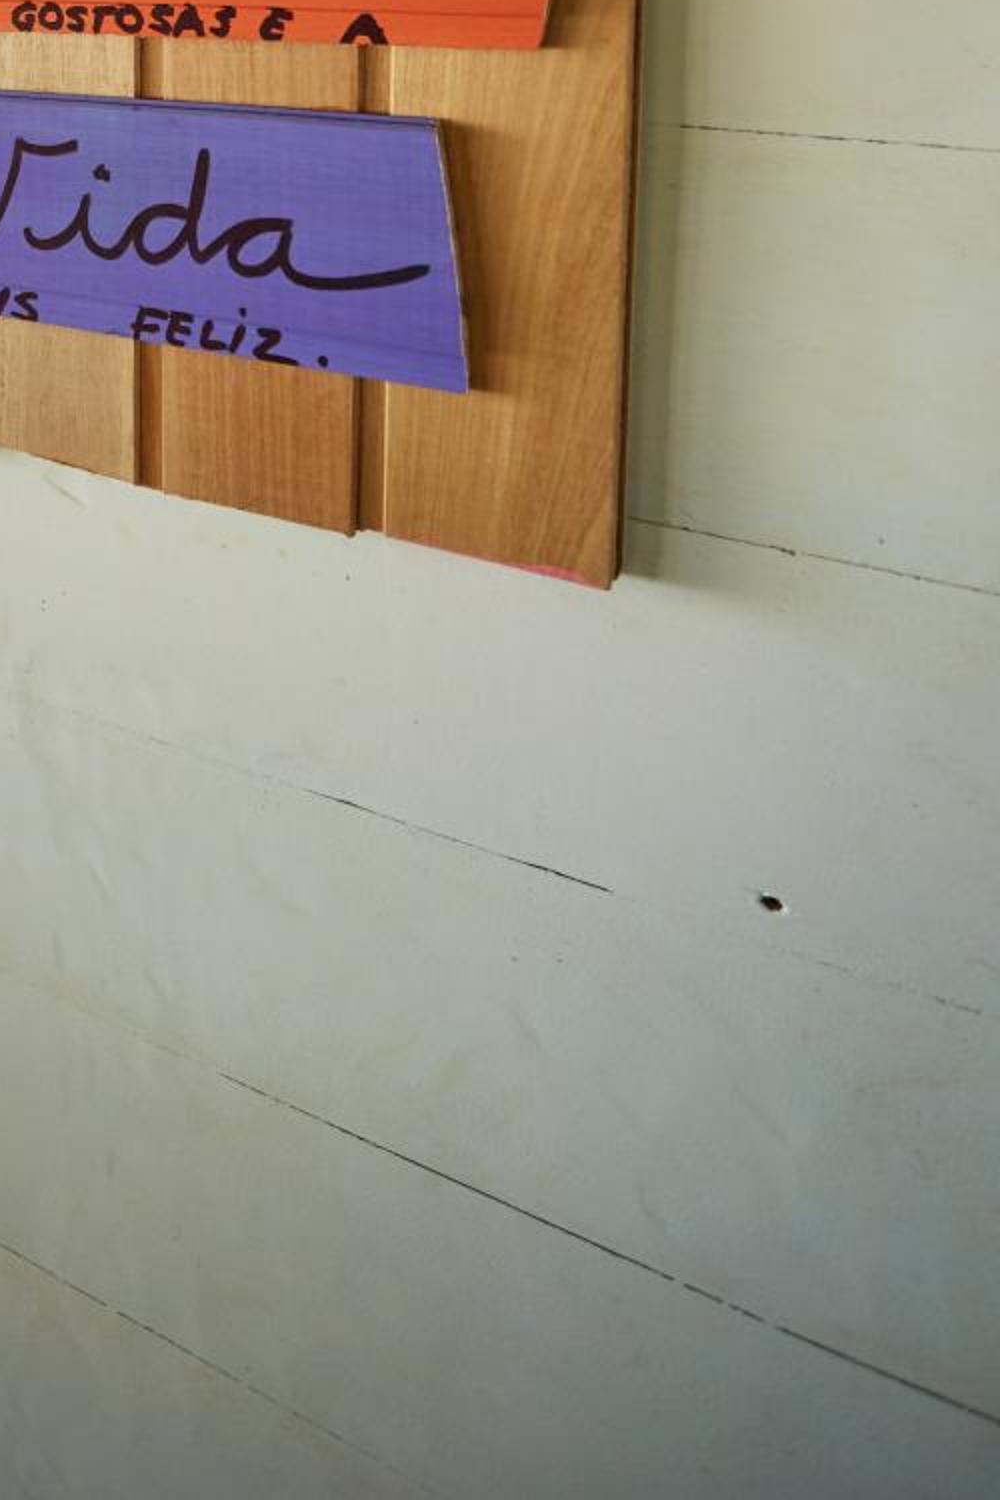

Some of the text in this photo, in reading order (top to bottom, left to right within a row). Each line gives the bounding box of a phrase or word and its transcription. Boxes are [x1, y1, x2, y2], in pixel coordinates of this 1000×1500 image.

[11, 1, 238, 38] GOSTOSAS
[258, 5, 295, 41] E
[339, 12, 390, 45] A
